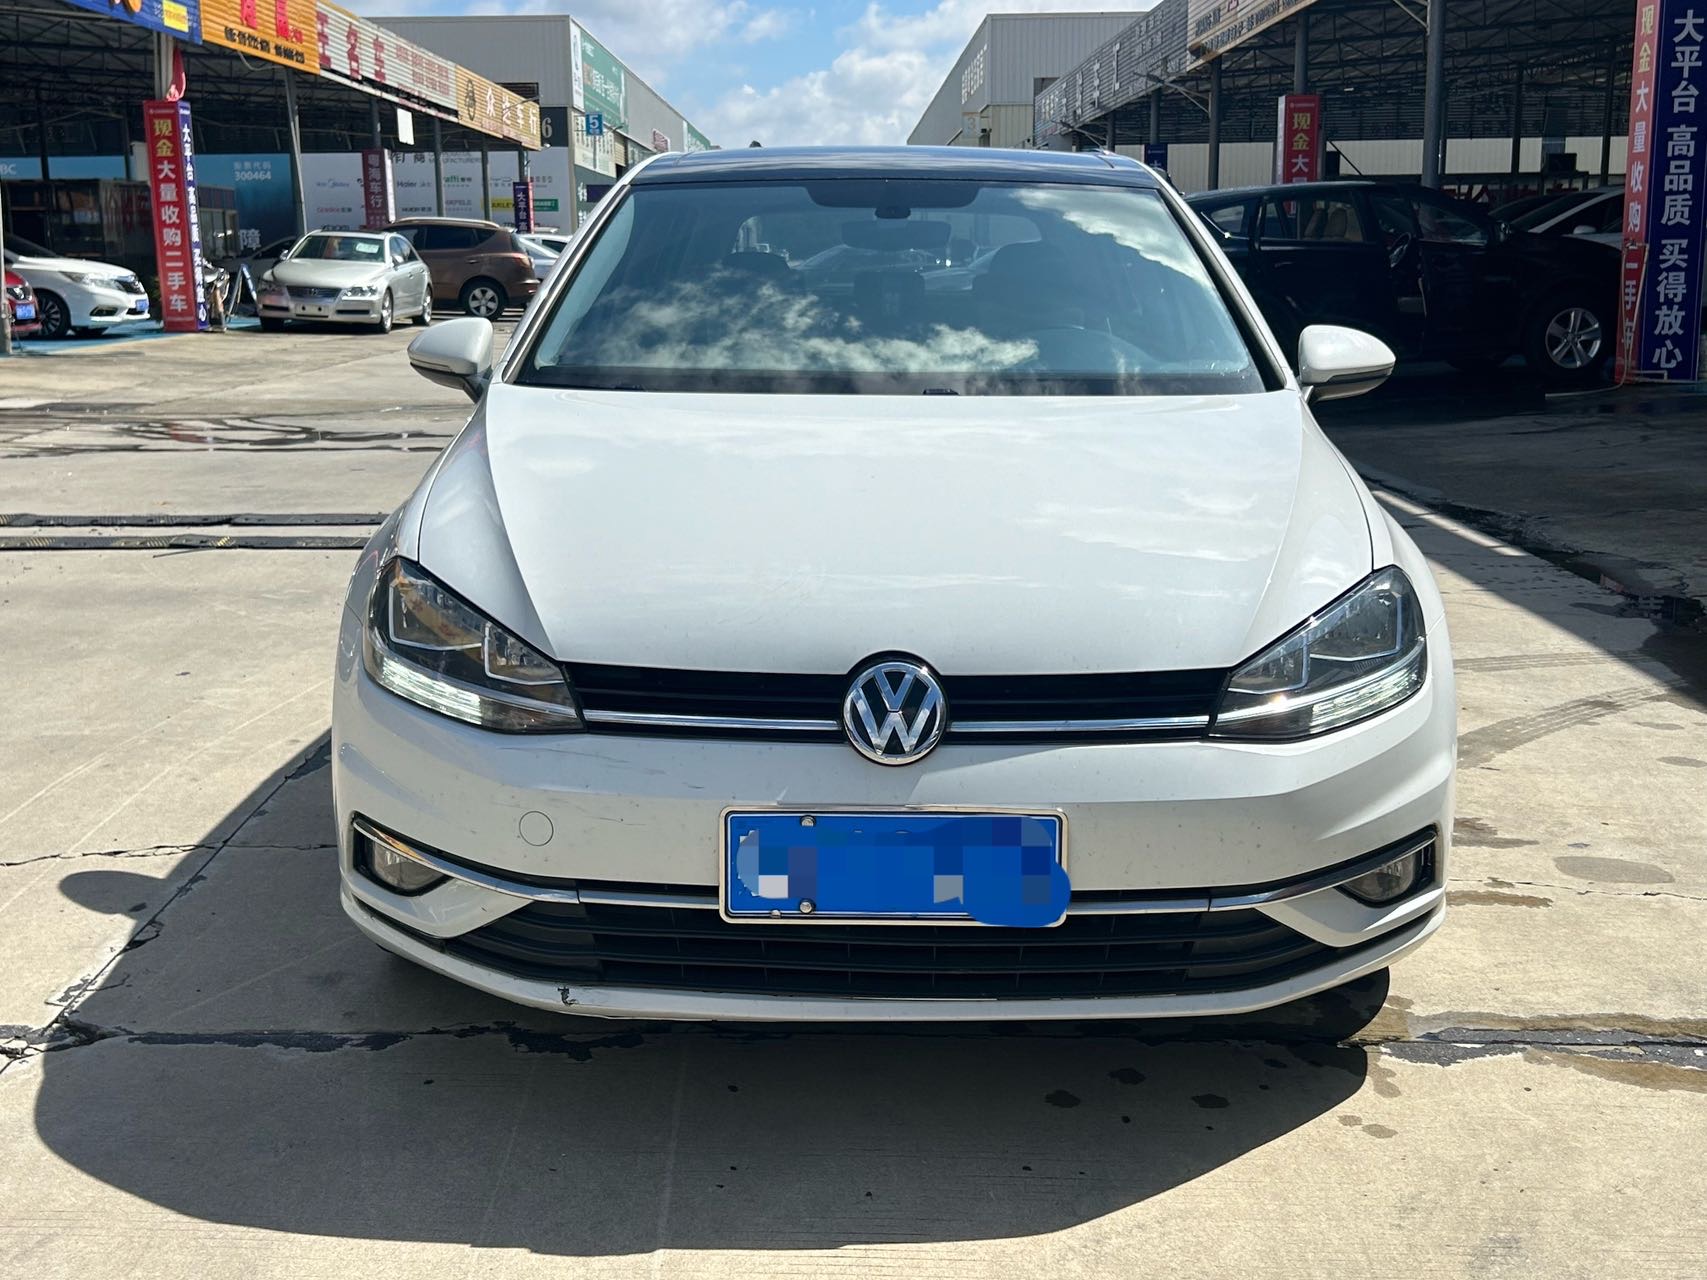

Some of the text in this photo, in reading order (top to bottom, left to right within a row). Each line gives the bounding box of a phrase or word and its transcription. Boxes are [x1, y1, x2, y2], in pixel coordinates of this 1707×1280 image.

[541, 117, 553, 139] 6
[589, 114, 600, 129] 5
[234, 171, 272, 181] 300464
[1652, 9, 1705, 370] 大平台 高品质 买得放心
[153, 118, 188, 313] 现金大量收购二手车
